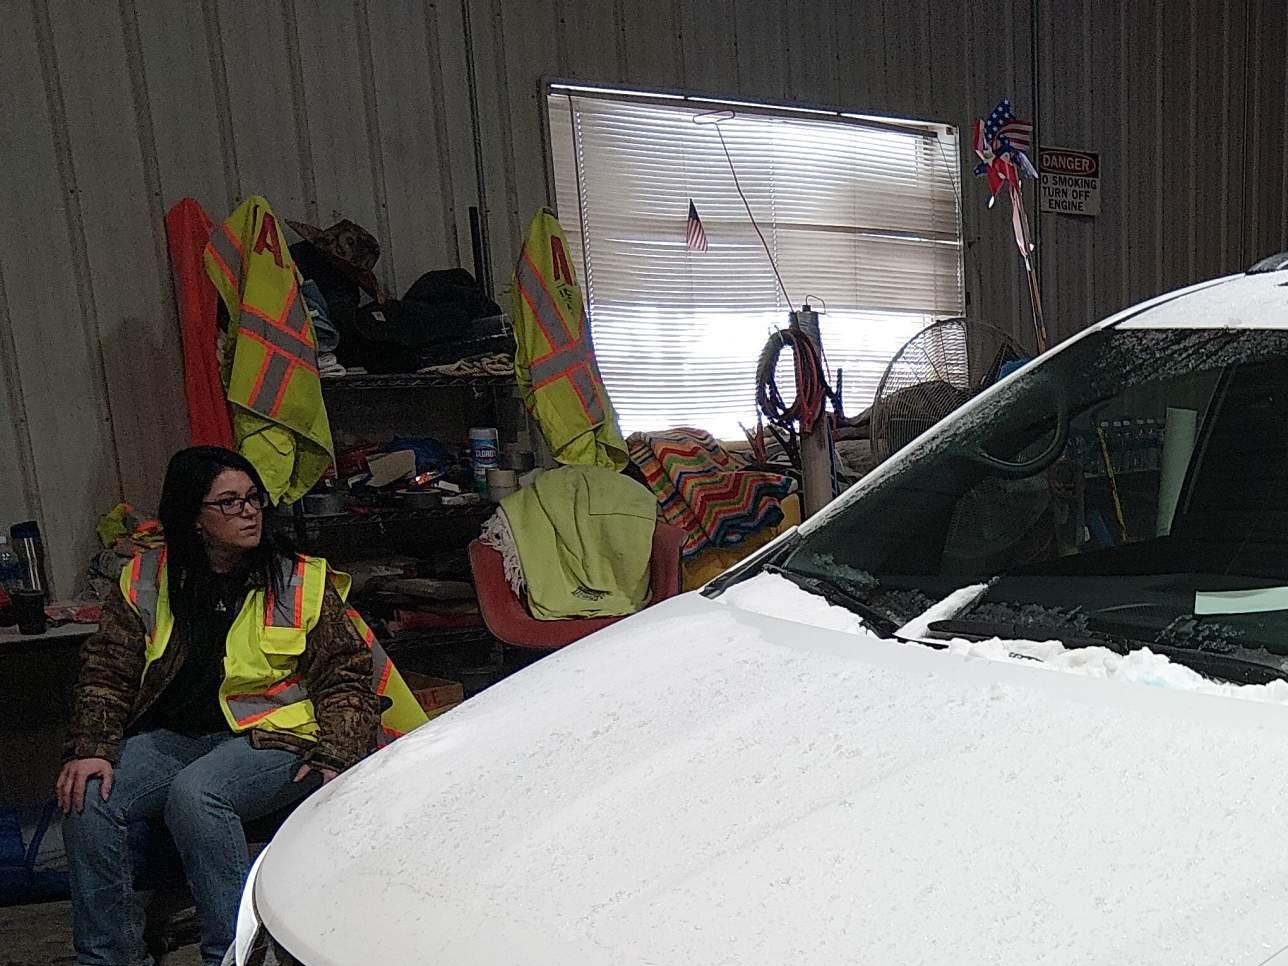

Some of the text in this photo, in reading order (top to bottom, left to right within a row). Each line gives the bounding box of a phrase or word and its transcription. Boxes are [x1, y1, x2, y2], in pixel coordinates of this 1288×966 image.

[1042, 154, 1090, 171] DANGER
[1040, 174, 1097, 190] O SMOKING
[1042, 186, 1091, 201] TURN OFF
[1048, 198, 1085, 212] ENGINE
[253, 211, 284, 269] A
